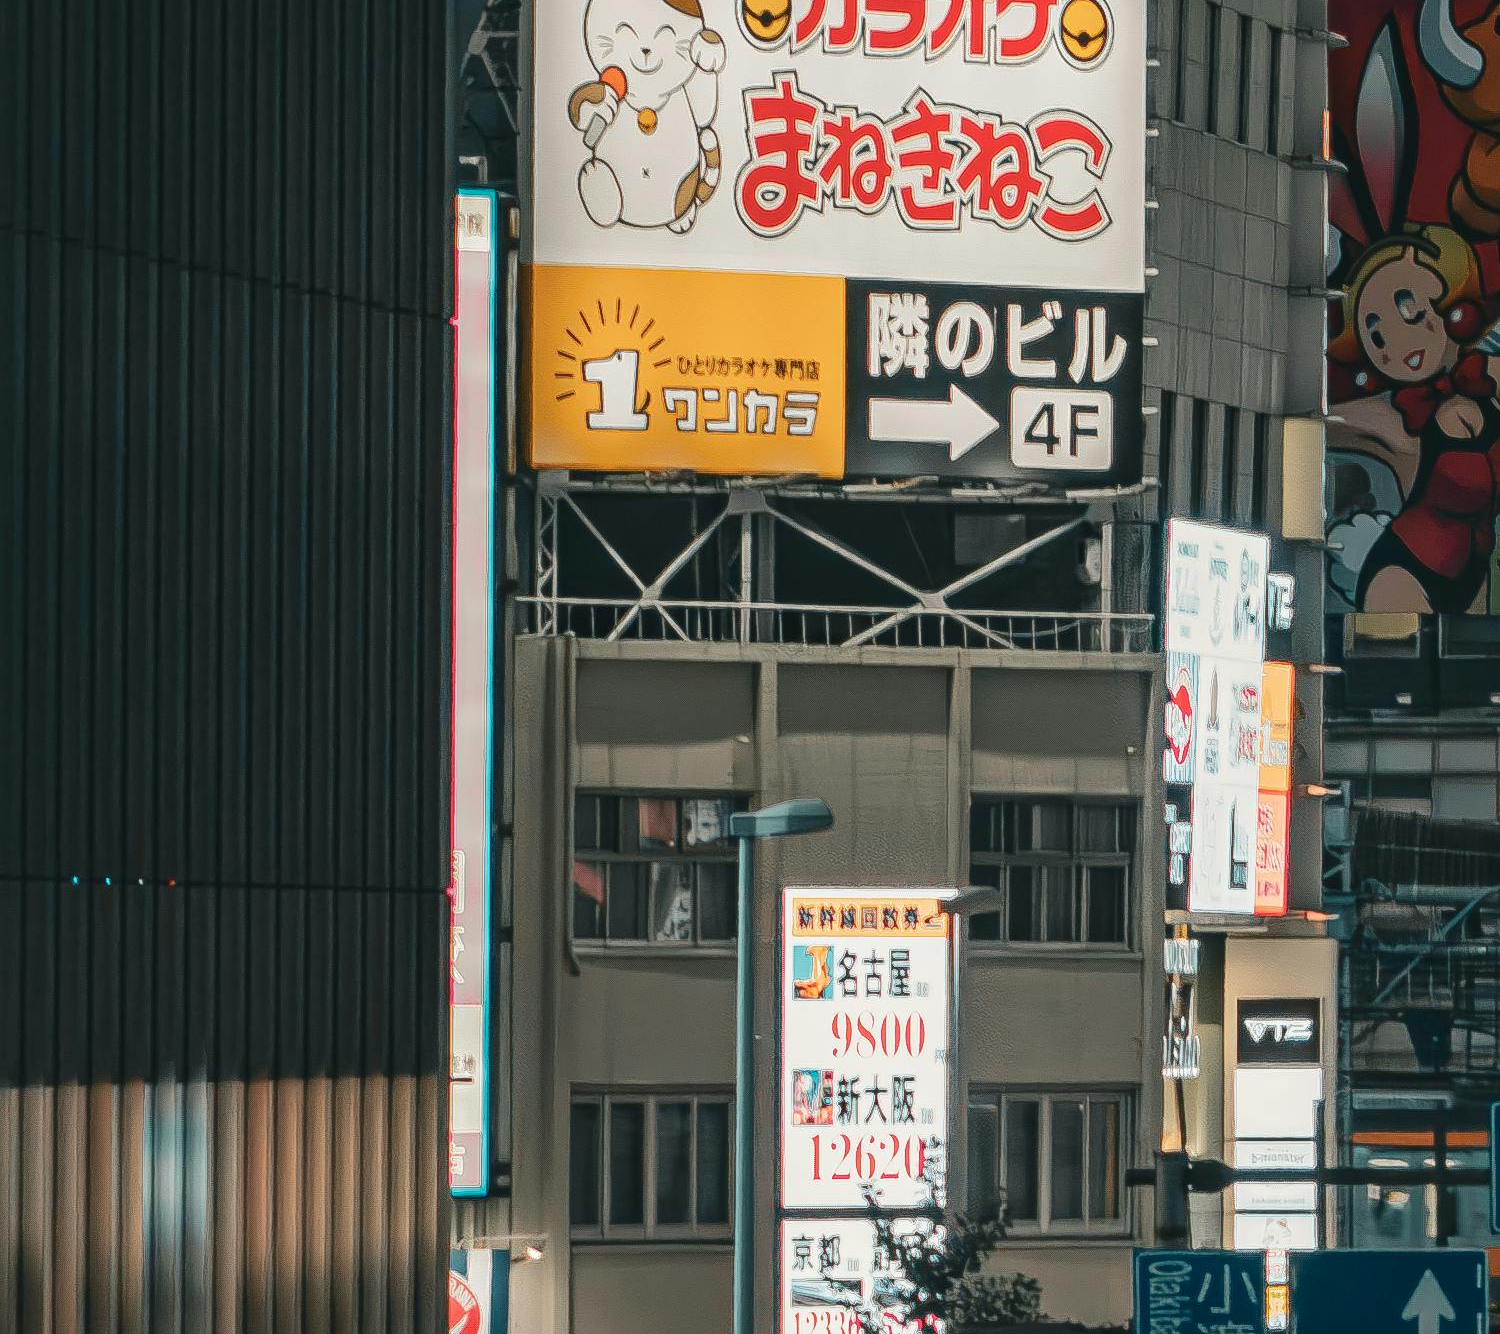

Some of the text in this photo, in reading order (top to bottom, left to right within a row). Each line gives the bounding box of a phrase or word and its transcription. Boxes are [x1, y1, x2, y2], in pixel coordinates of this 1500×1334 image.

[738, 75, 1112, 237] まねきねこ
[865, 291, 1128, 385] 隣のビル
[676, 353, 821, 381] ひとりカラオケ専門店
[662, 386, 823, 438] ワンカラ
[1021, 401, 1103, 460] 4F
[836, 948, 912, 999] 名古屋
[830, 1009, 927, 1059] 9800
[835, 1073, 918, 1125] 新大阪
[811, 1132, 925, 1181] 12620
[791, 1233, 842, 1273] 京都
